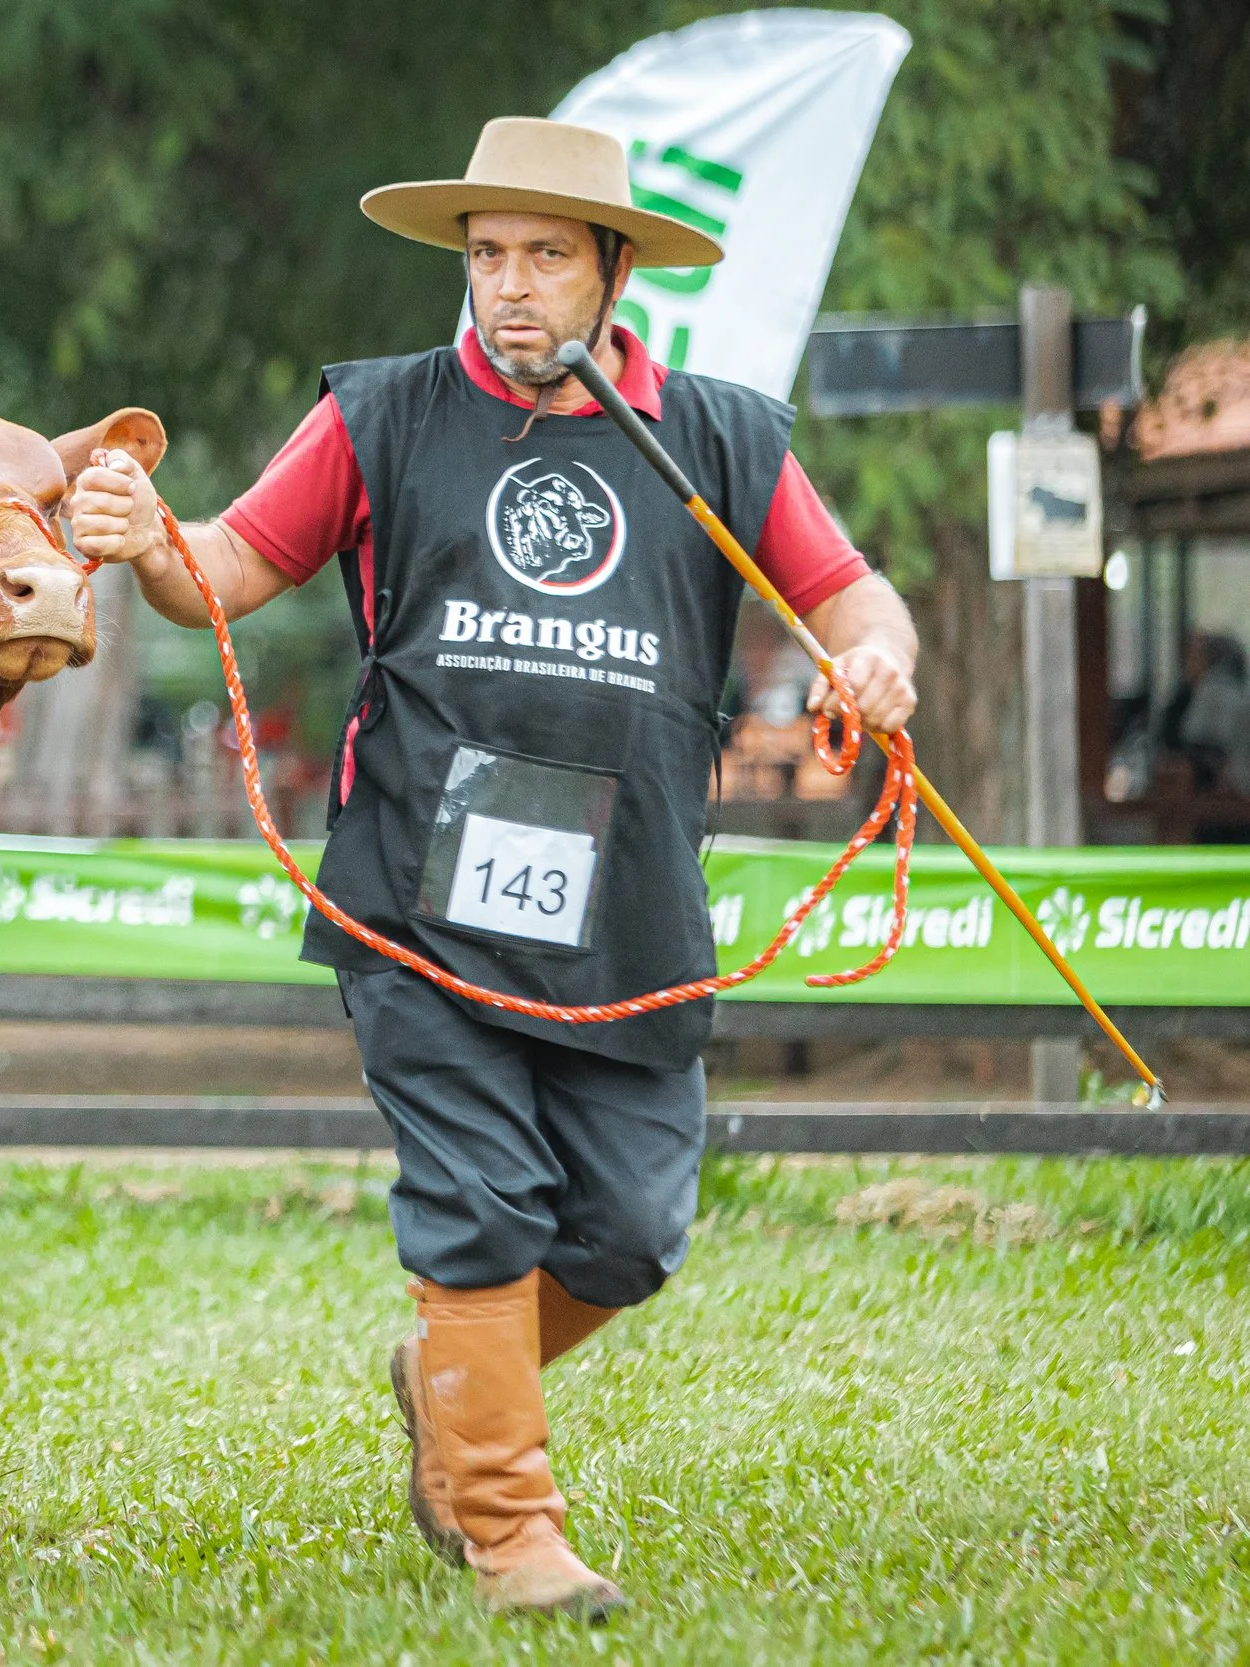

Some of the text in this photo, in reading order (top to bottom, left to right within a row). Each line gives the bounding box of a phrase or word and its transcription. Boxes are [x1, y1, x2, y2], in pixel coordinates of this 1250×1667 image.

[439, 600, 659, 666] Brangus
[436, 654, 655, 694] ASSOCIAÇÃO BRASILEIRA DE BRANGUS
[475, 857, 568, 916] 143
